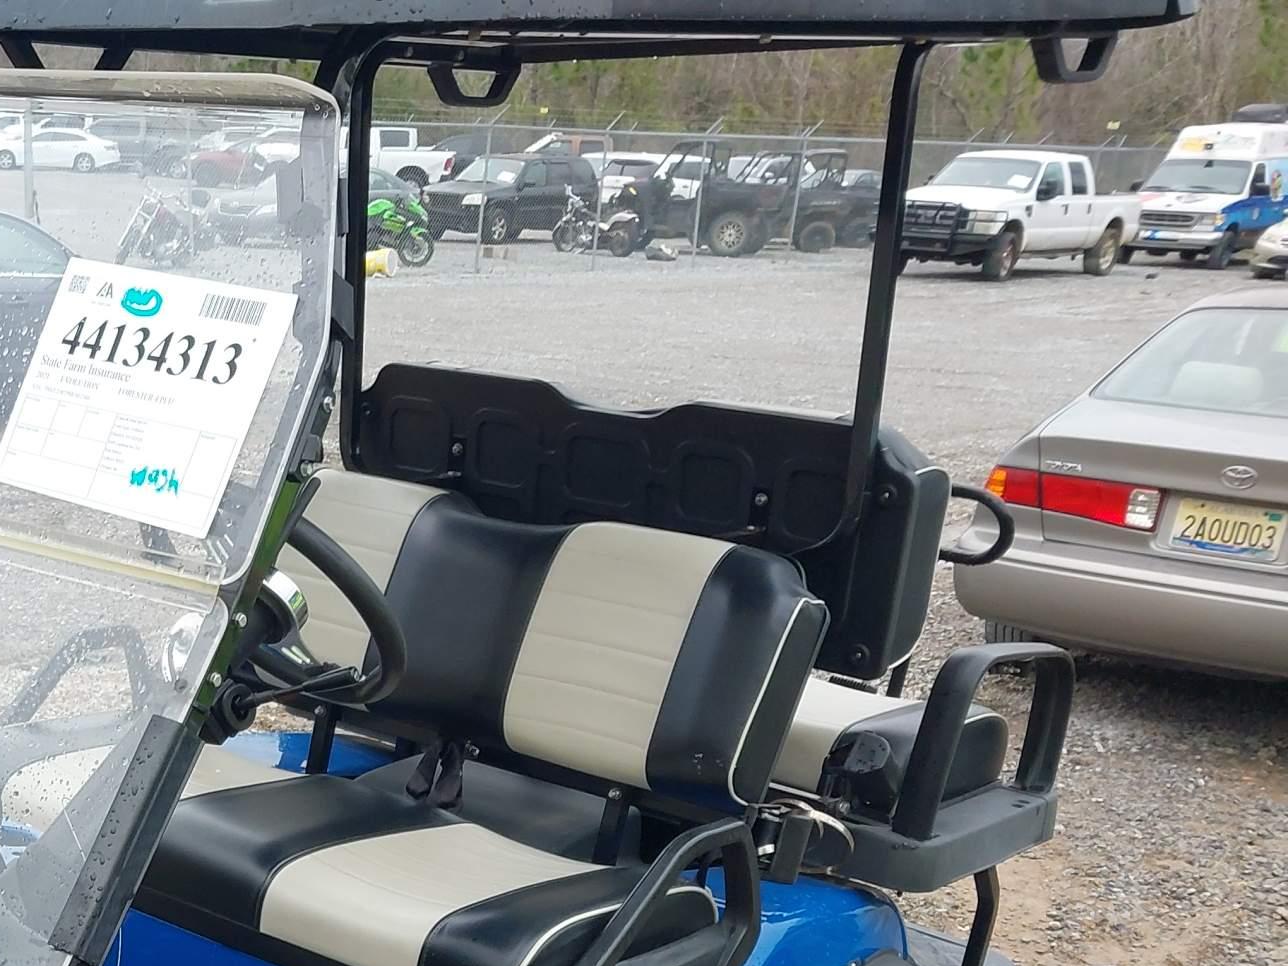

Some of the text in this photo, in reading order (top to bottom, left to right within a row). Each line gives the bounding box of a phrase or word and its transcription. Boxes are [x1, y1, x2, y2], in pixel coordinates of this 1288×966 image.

[40, 353, 132, 383] State Farm Insurance
[61, 316, 244, 385] 44134313
